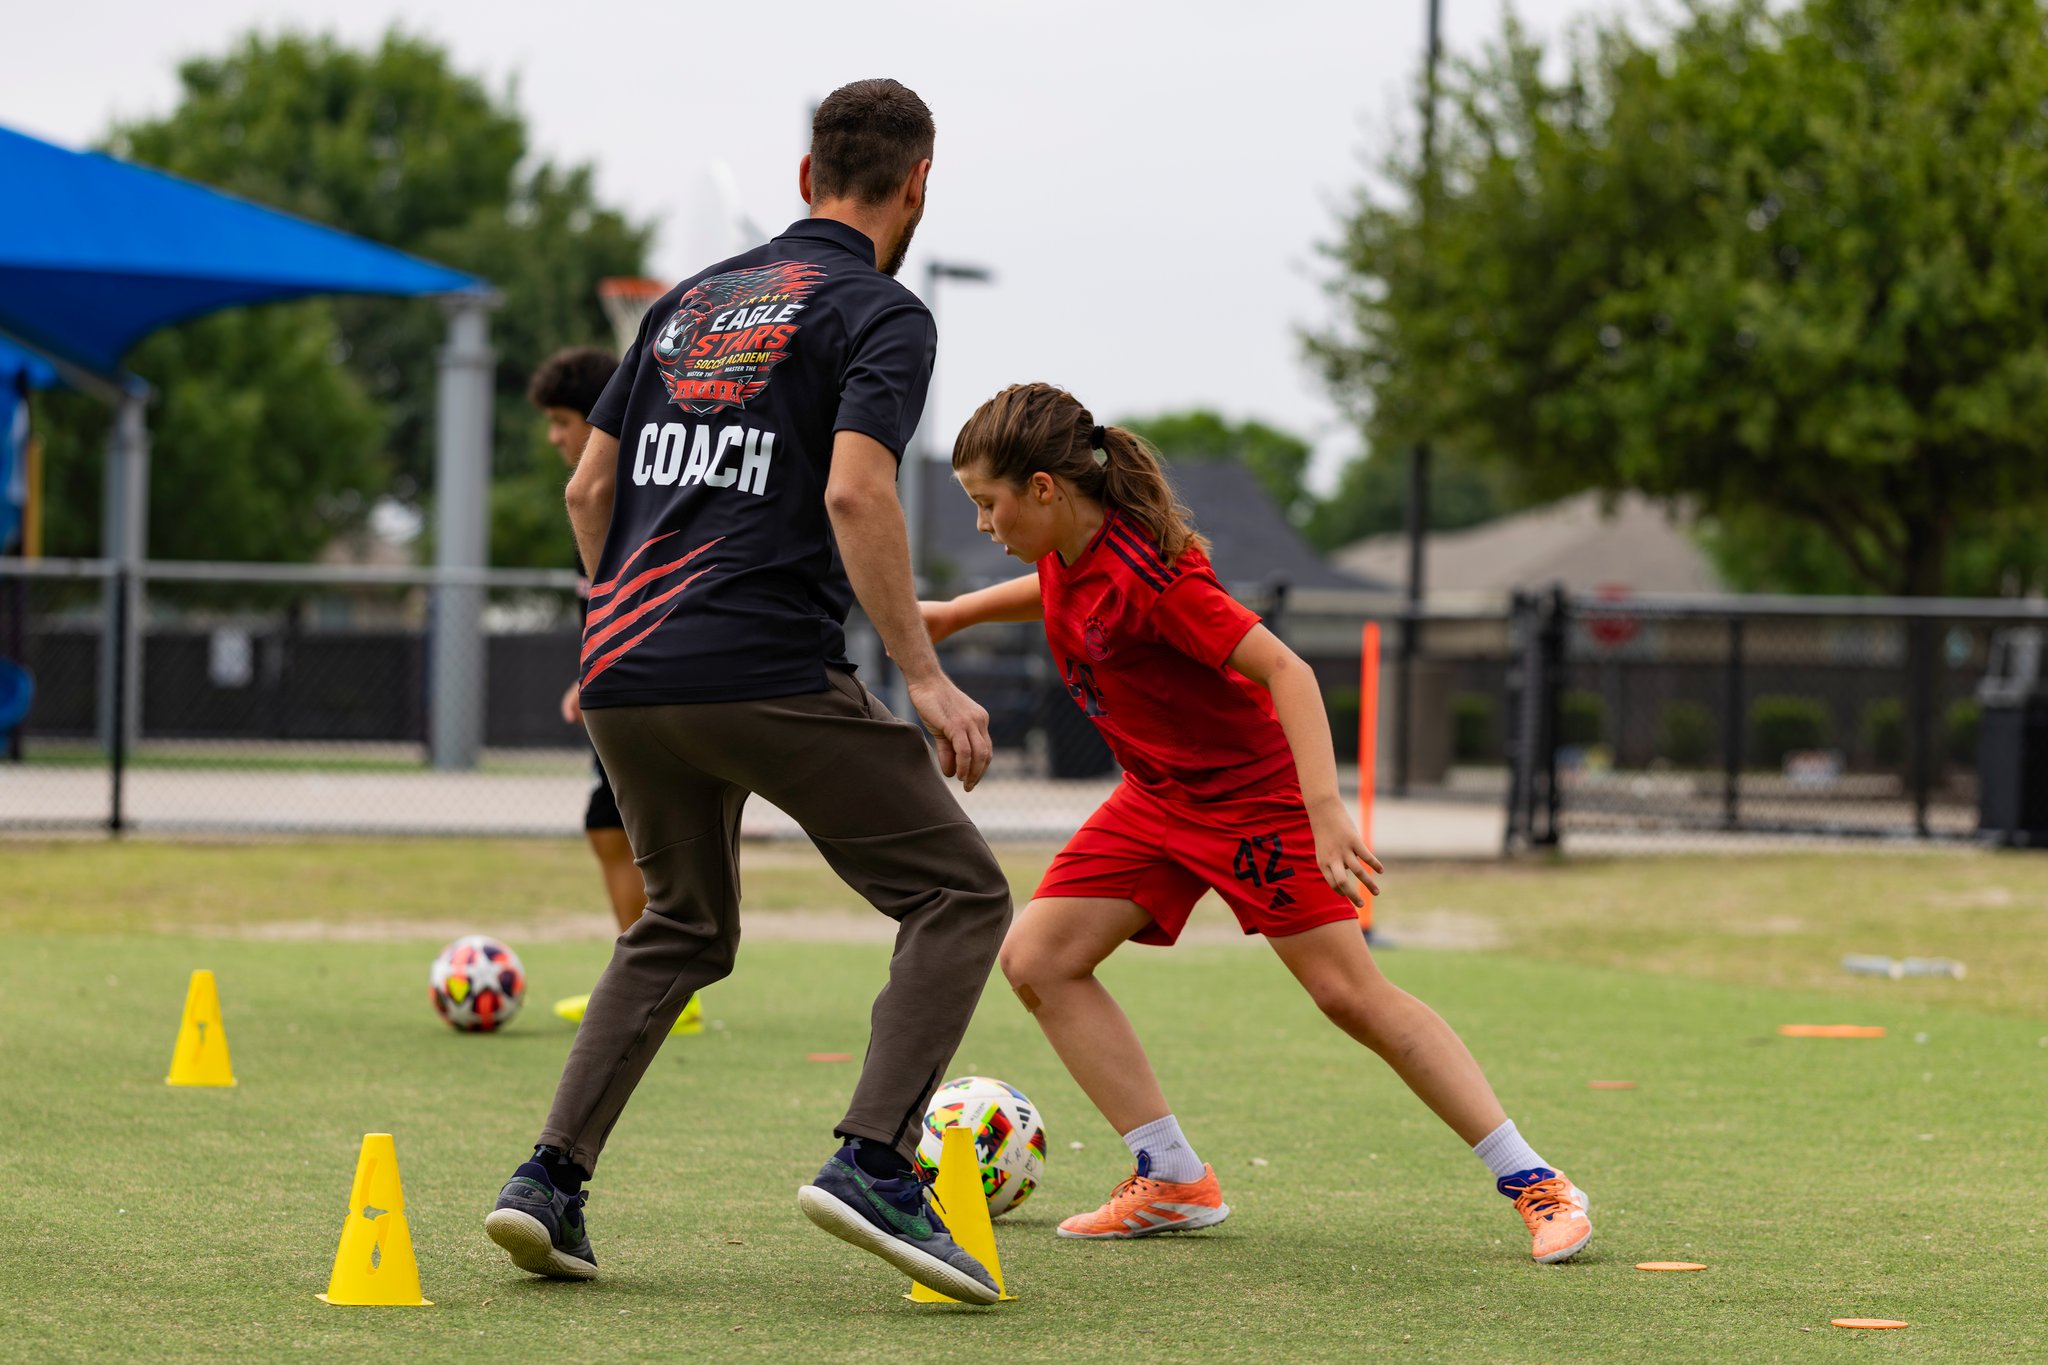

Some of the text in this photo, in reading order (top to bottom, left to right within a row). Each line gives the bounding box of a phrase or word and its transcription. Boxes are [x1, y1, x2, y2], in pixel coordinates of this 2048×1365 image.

[709, 303, 805, 333] EAGLE
[689, 324, 798, 357] STARS
[725, 351, 771, 365] ACADEMY
[632, 422, 776, 497] COACH
[1233, 834, 1296, 888] 42
